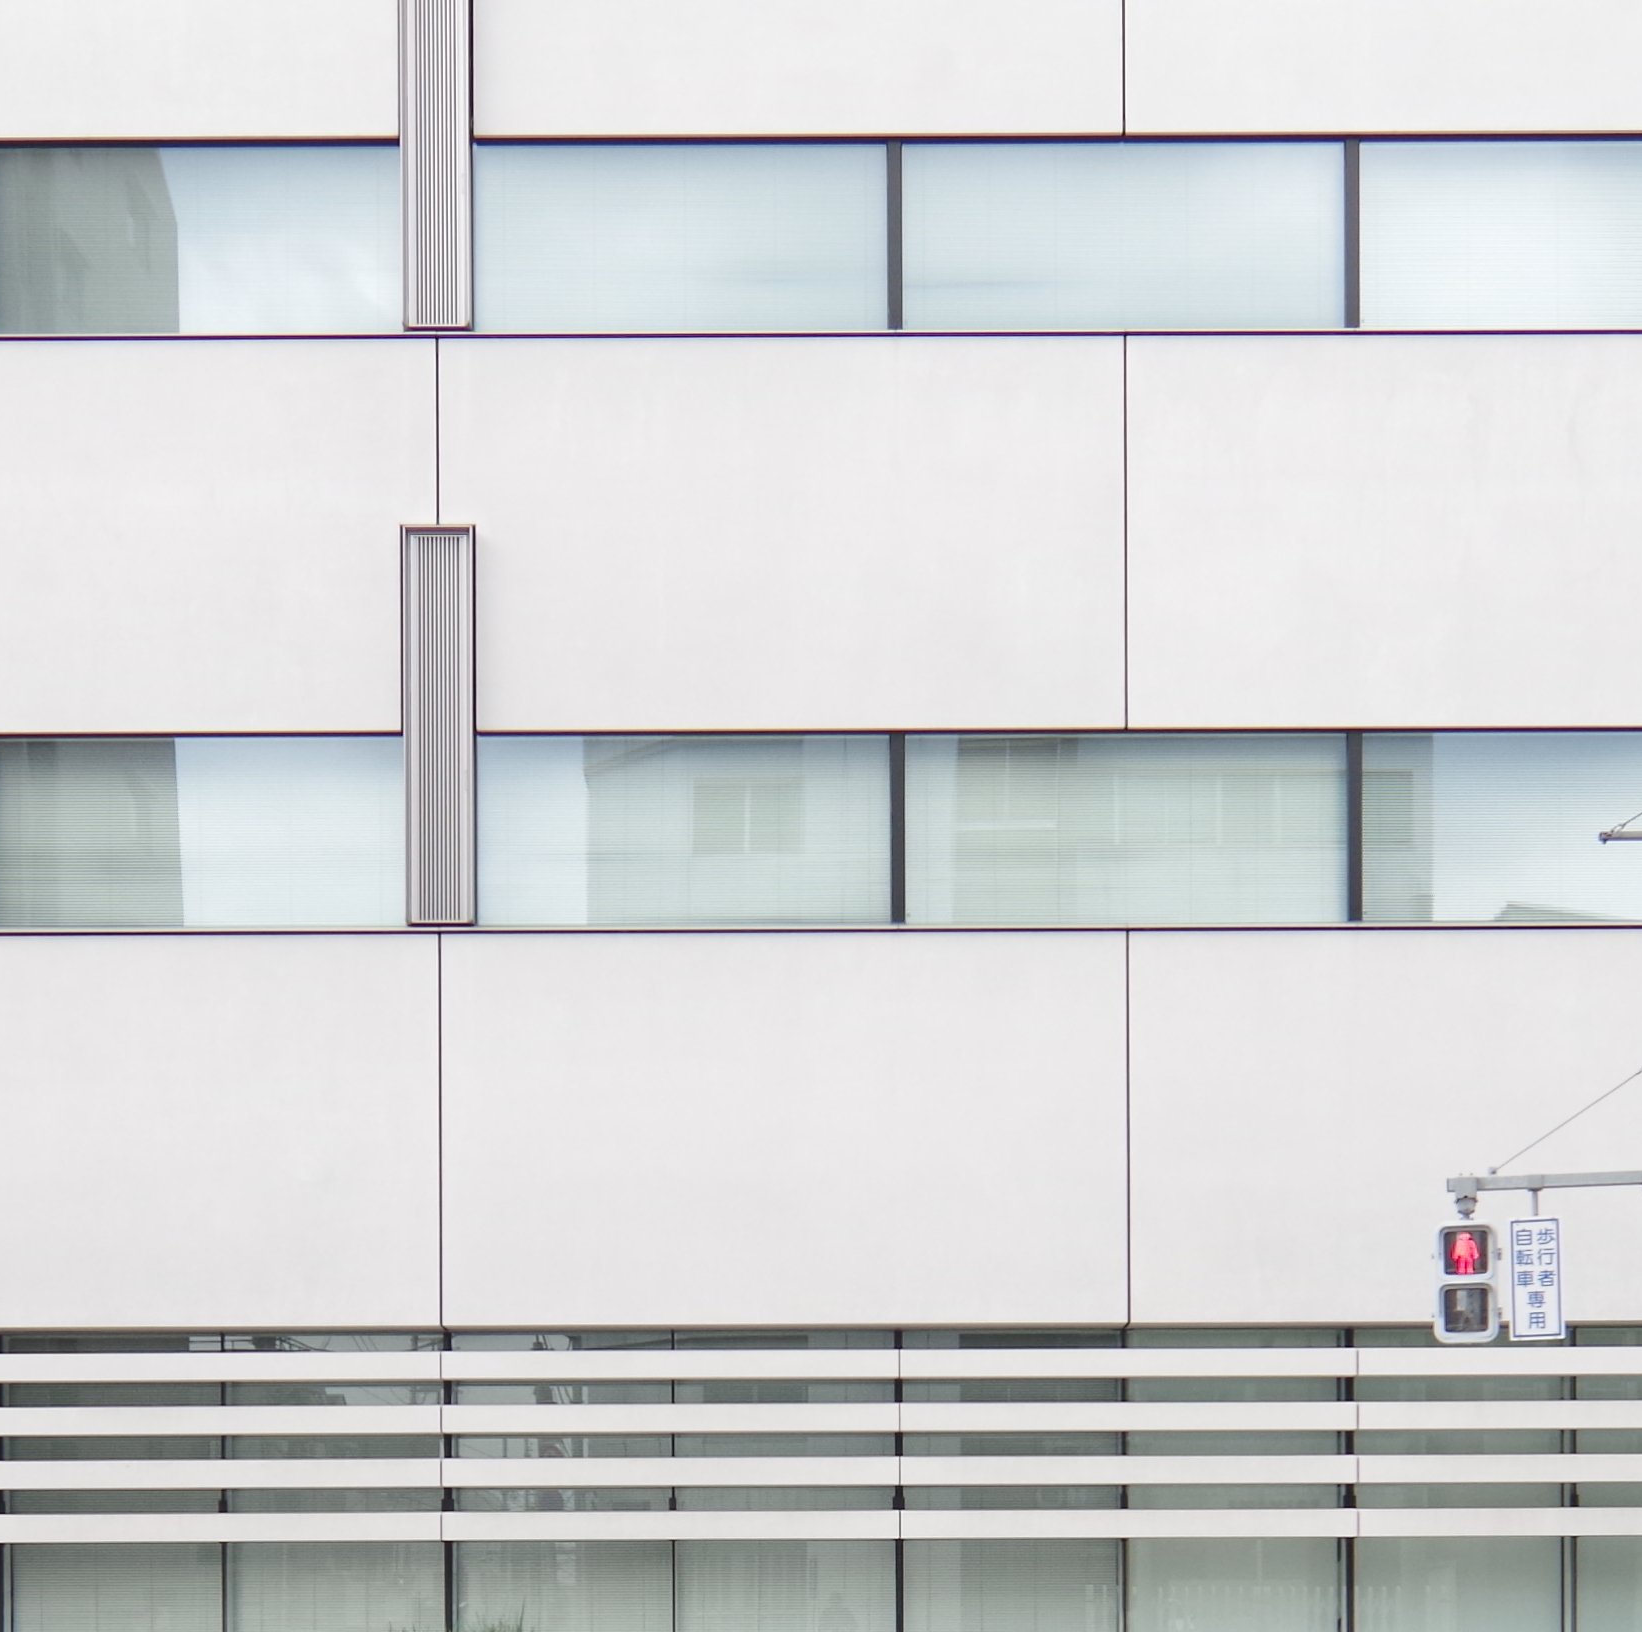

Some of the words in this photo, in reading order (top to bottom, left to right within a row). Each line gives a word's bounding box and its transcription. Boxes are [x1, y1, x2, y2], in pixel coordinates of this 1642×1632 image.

[1515, 1229, 1535, 1287] 自転車
[1537, 1228, 1556, 1287] 歩行者
[1527, 1291, 1547, 1329] 専用
